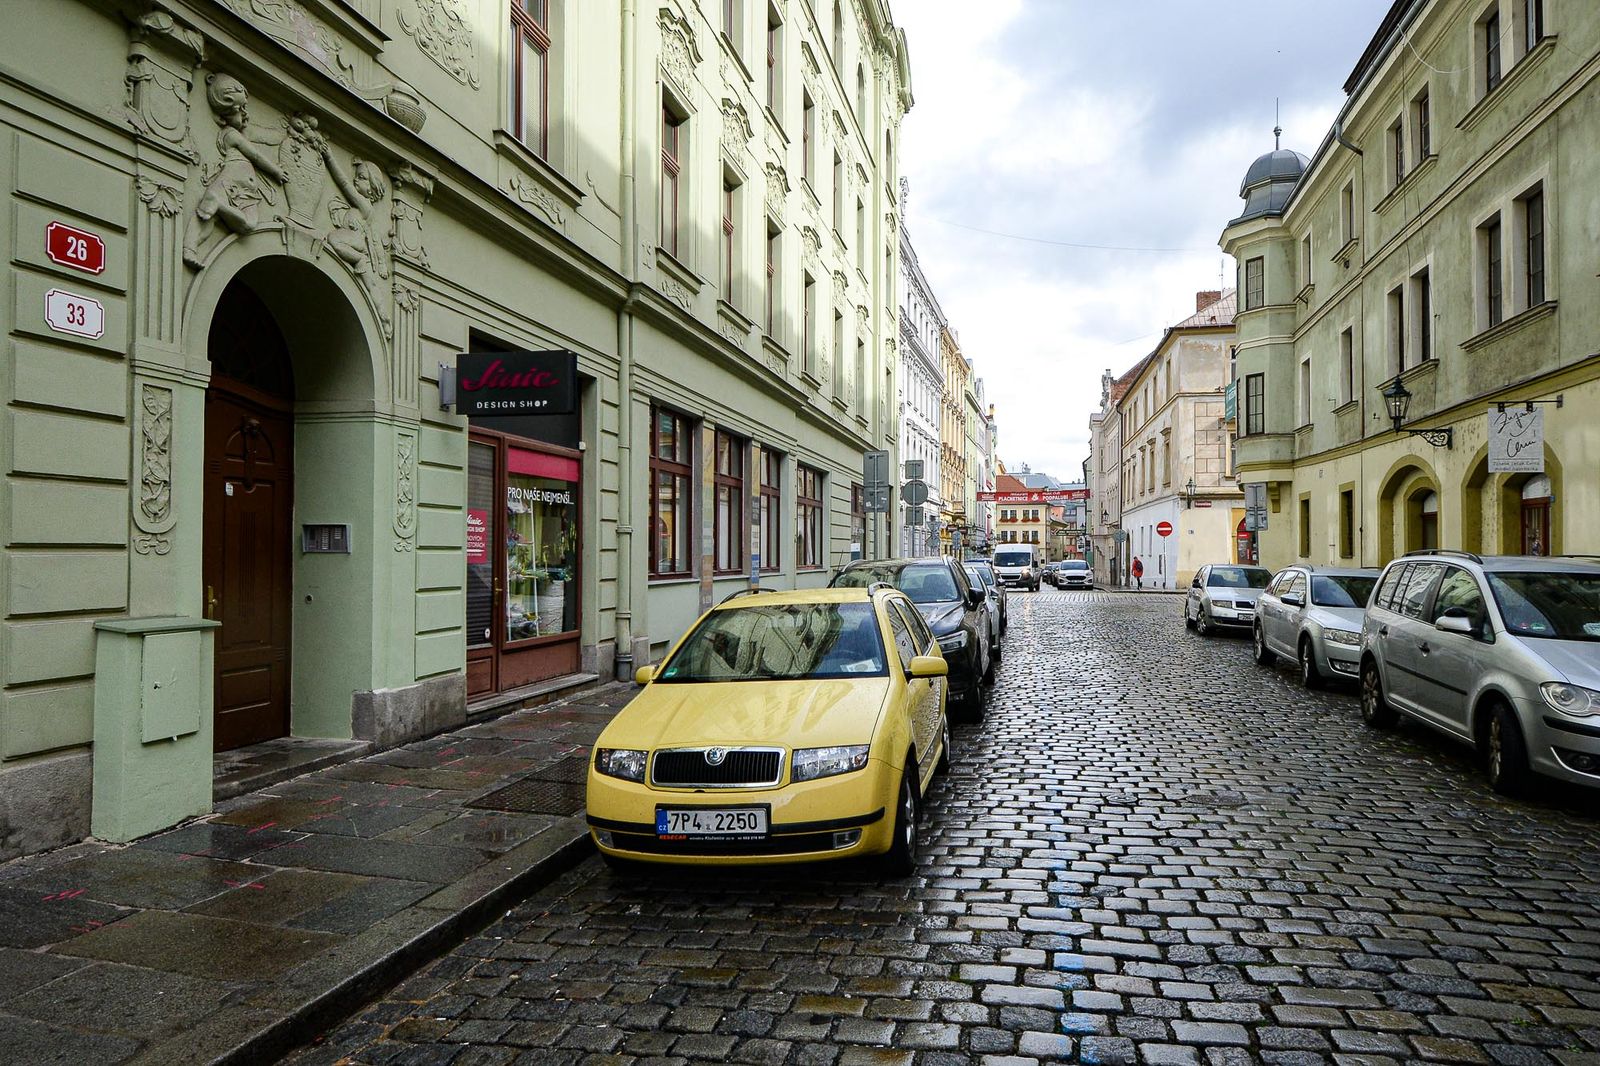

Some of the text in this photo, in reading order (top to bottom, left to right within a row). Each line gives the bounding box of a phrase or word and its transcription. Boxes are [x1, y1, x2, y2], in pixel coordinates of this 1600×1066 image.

[66, 236, 87, 261] 26
[66, 303, 85, 326] 33
[476, 400, 548, 409] DESIGN SHOP
[507, 486, 522, 499] PRO
[523, 487, 541, 501] NAŠE
[671, 812, 758, 831] 7P4 2250
